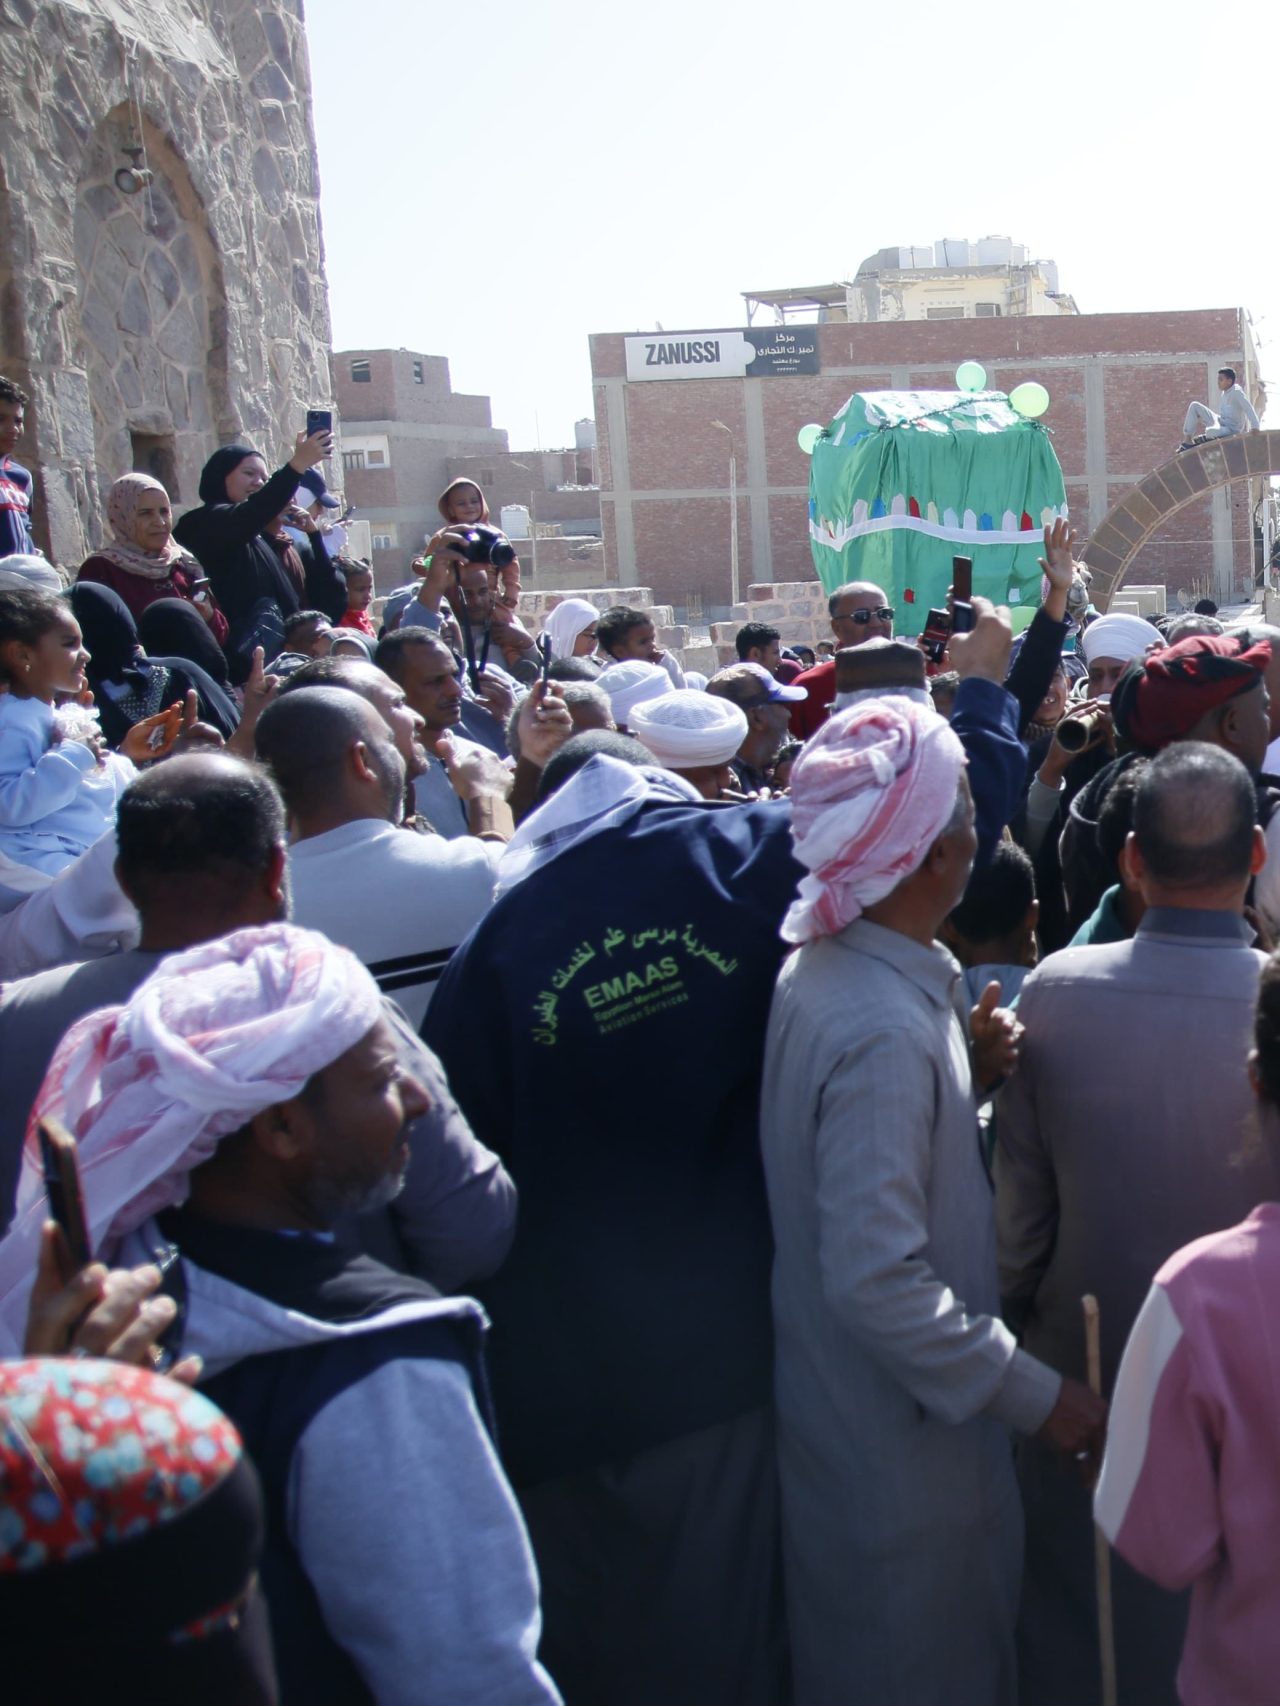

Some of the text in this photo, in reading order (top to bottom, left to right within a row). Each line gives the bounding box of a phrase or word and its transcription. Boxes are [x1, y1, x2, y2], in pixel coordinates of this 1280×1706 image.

[645, 341, 720, 366] ZANUSSI
[775, 333, 796, 343] مركز
[530, 923, 739, 1046] المصرية مرسى علم لخدمات الطيران
[584, 956, 680, 1009] EMAAS
[598, 992, 690, 1036] Aviation Services
